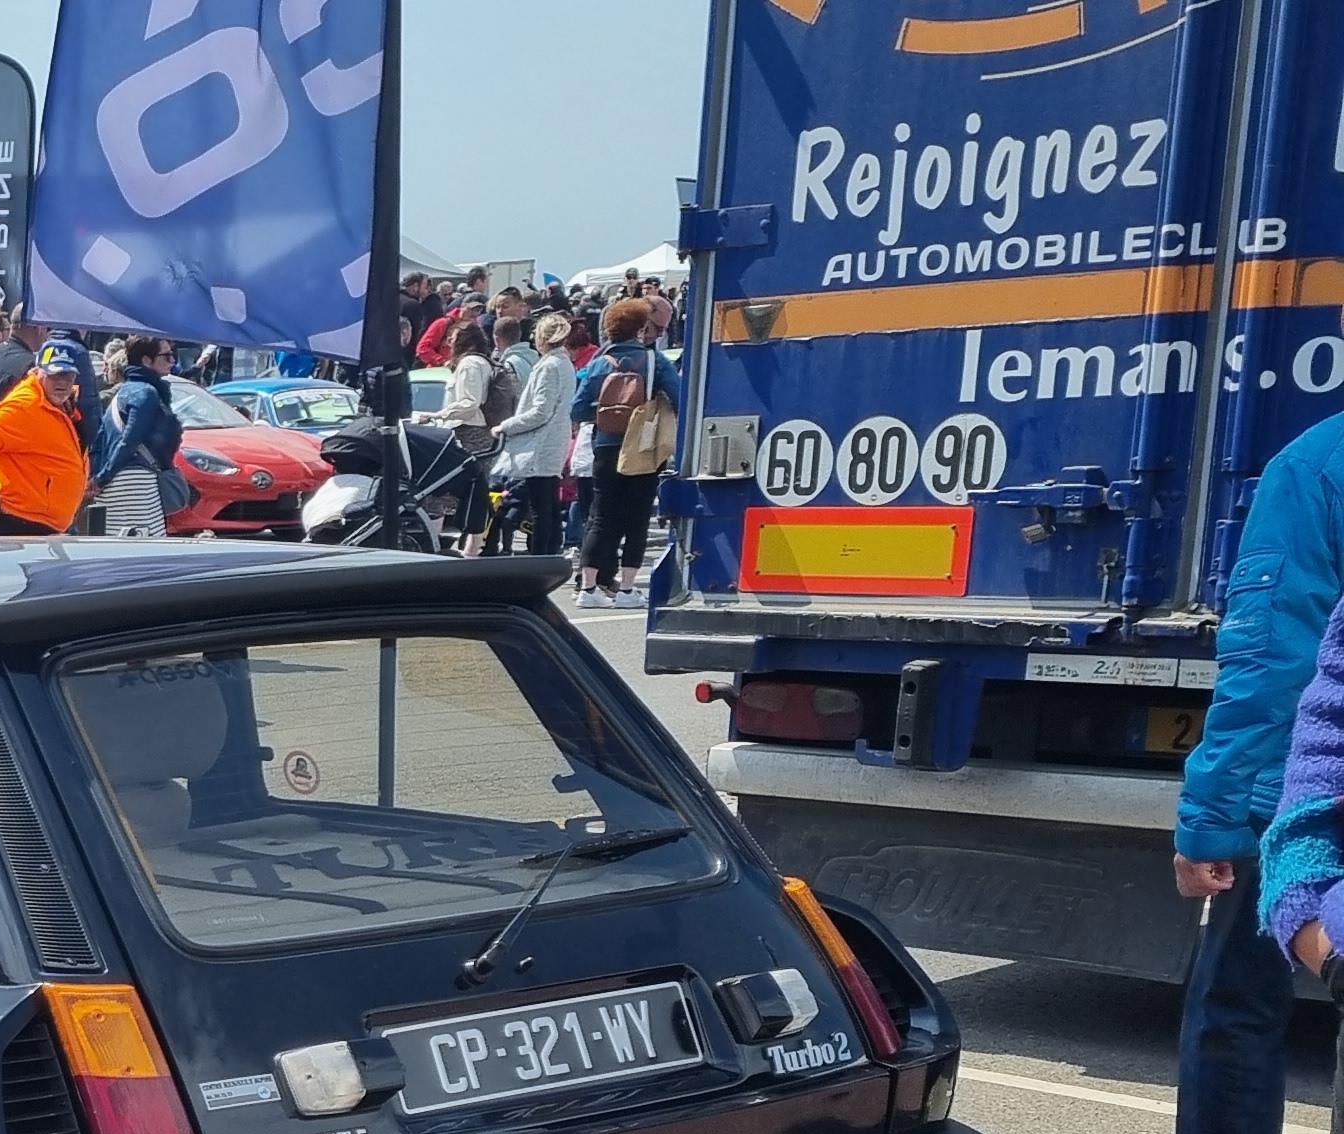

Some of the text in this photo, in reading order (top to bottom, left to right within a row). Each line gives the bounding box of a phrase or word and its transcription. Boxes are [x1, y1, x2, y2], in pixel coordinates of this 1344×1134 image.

[792, 112, 1168, 246] Rejoignez
[766, 430, 822, 496] 60
[848, 426, 908, 494] 80
[932, 424, 995, 493] 90
[429, 1000, 657, 1094] CP-321-WY
